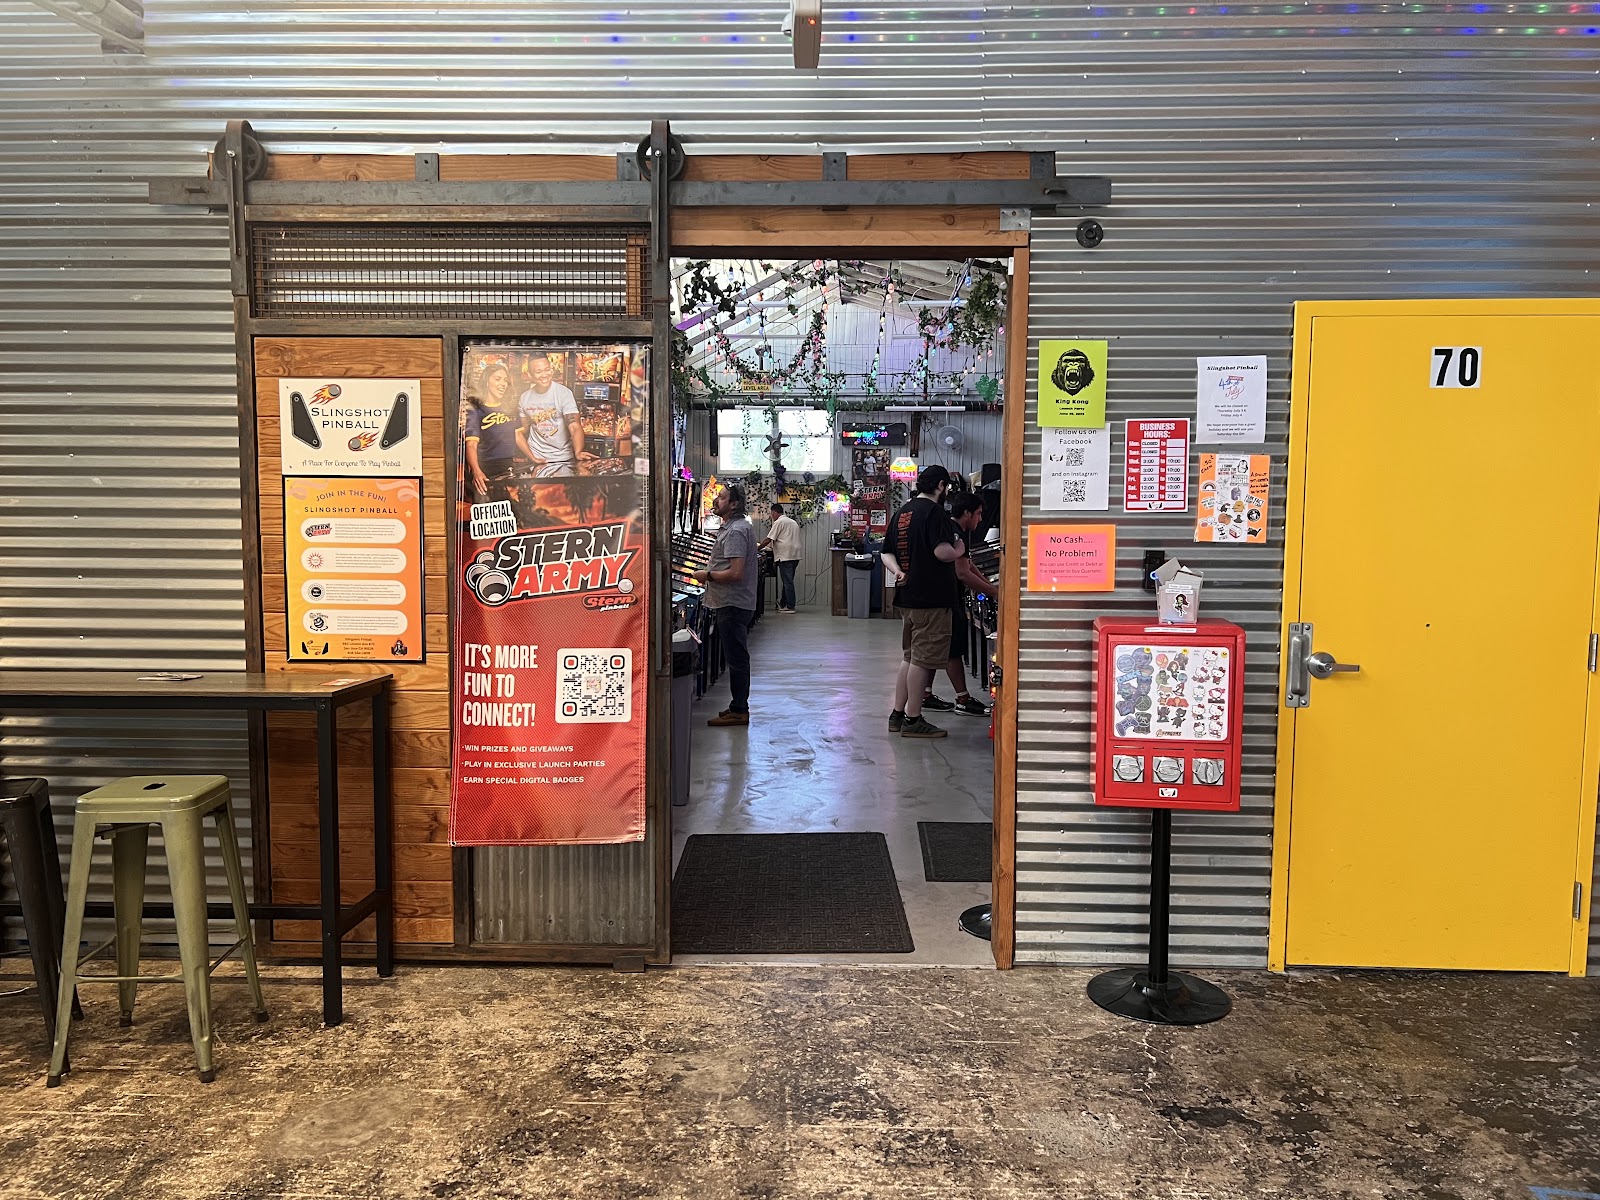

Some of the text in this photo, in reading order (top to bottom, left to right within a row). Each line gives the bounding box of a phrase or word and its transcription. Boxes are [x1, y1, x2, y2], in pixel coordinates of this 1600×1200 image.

[1435, 348, 1478, 386] 70
[311, 408, 390, 416] SLINGSHOT
[335, 460, 358, 468] Everyone
[369, 460, 381, 469] Play
[316, 492, 334, 501] JOIN
[368, 493, 387, 503] FUN!
[473, 502, 512, 520] OFFICIAL
[472, 521, 515, 536] LOCATION
[496, 526, 623, 569] STERN
[511, 550, 634, 598] ARMY
[585, 596, 634, 607] Stern
[465, 643, 538, 668] IT'S MORE
[464, 673, 515, 697] FUN TO
[463, 701, 536, 726] CONNECT!
[463, 776, 483, 784] EARN
[552, 776, 584, 784] BADGES
